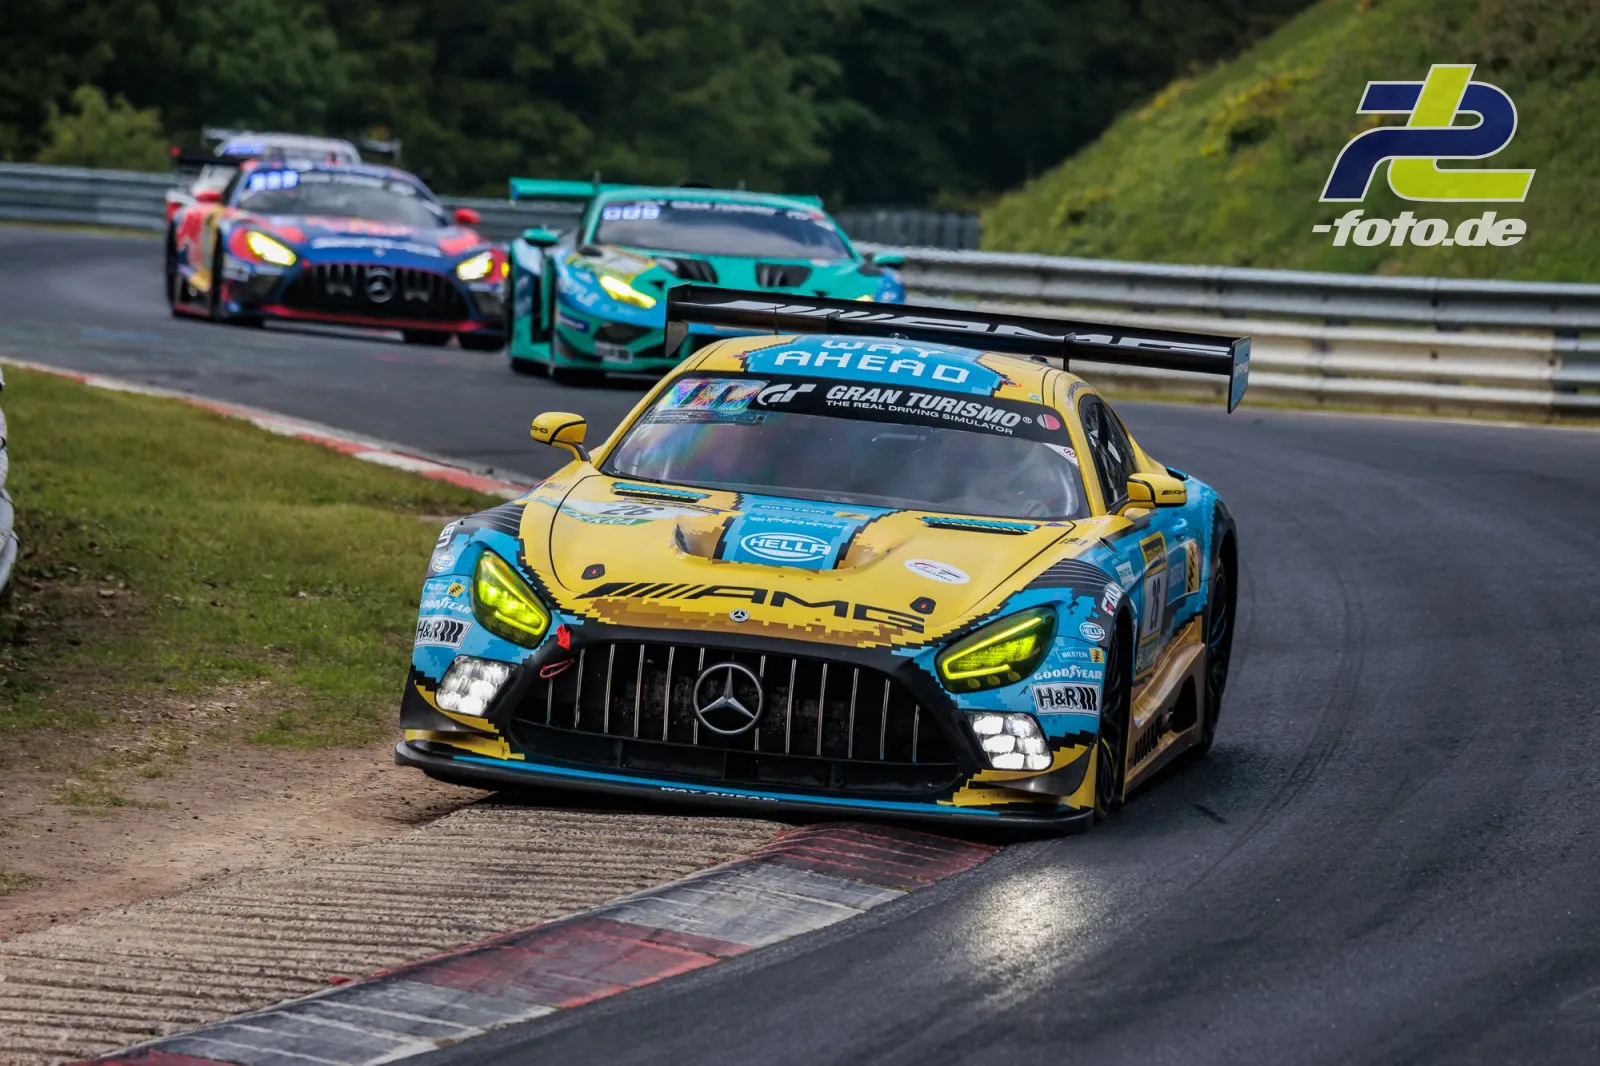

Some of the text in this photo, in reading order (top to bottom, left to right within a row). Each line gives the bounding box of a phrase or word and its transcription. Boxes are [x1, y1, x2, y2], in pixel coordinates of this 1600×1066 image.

[821, 339, 945, 359] WAY
[774, 350, 970, 384] AHEAD
[826, 385, 903, 404] GRAN
[826, 400, 1014, 435] THE REAL DRIVING SIMULATOR
[749, 537, 832, 556] HELLA
[681, 585, 926, 634] AMG
[1081, 627, 1106, 637] HELLA
[1061, 651, 1088, 659] BILSTEIN
[1033, 664, 1103, 680] GOODYEAR
[1036, 686, 1078, 707] H&R
